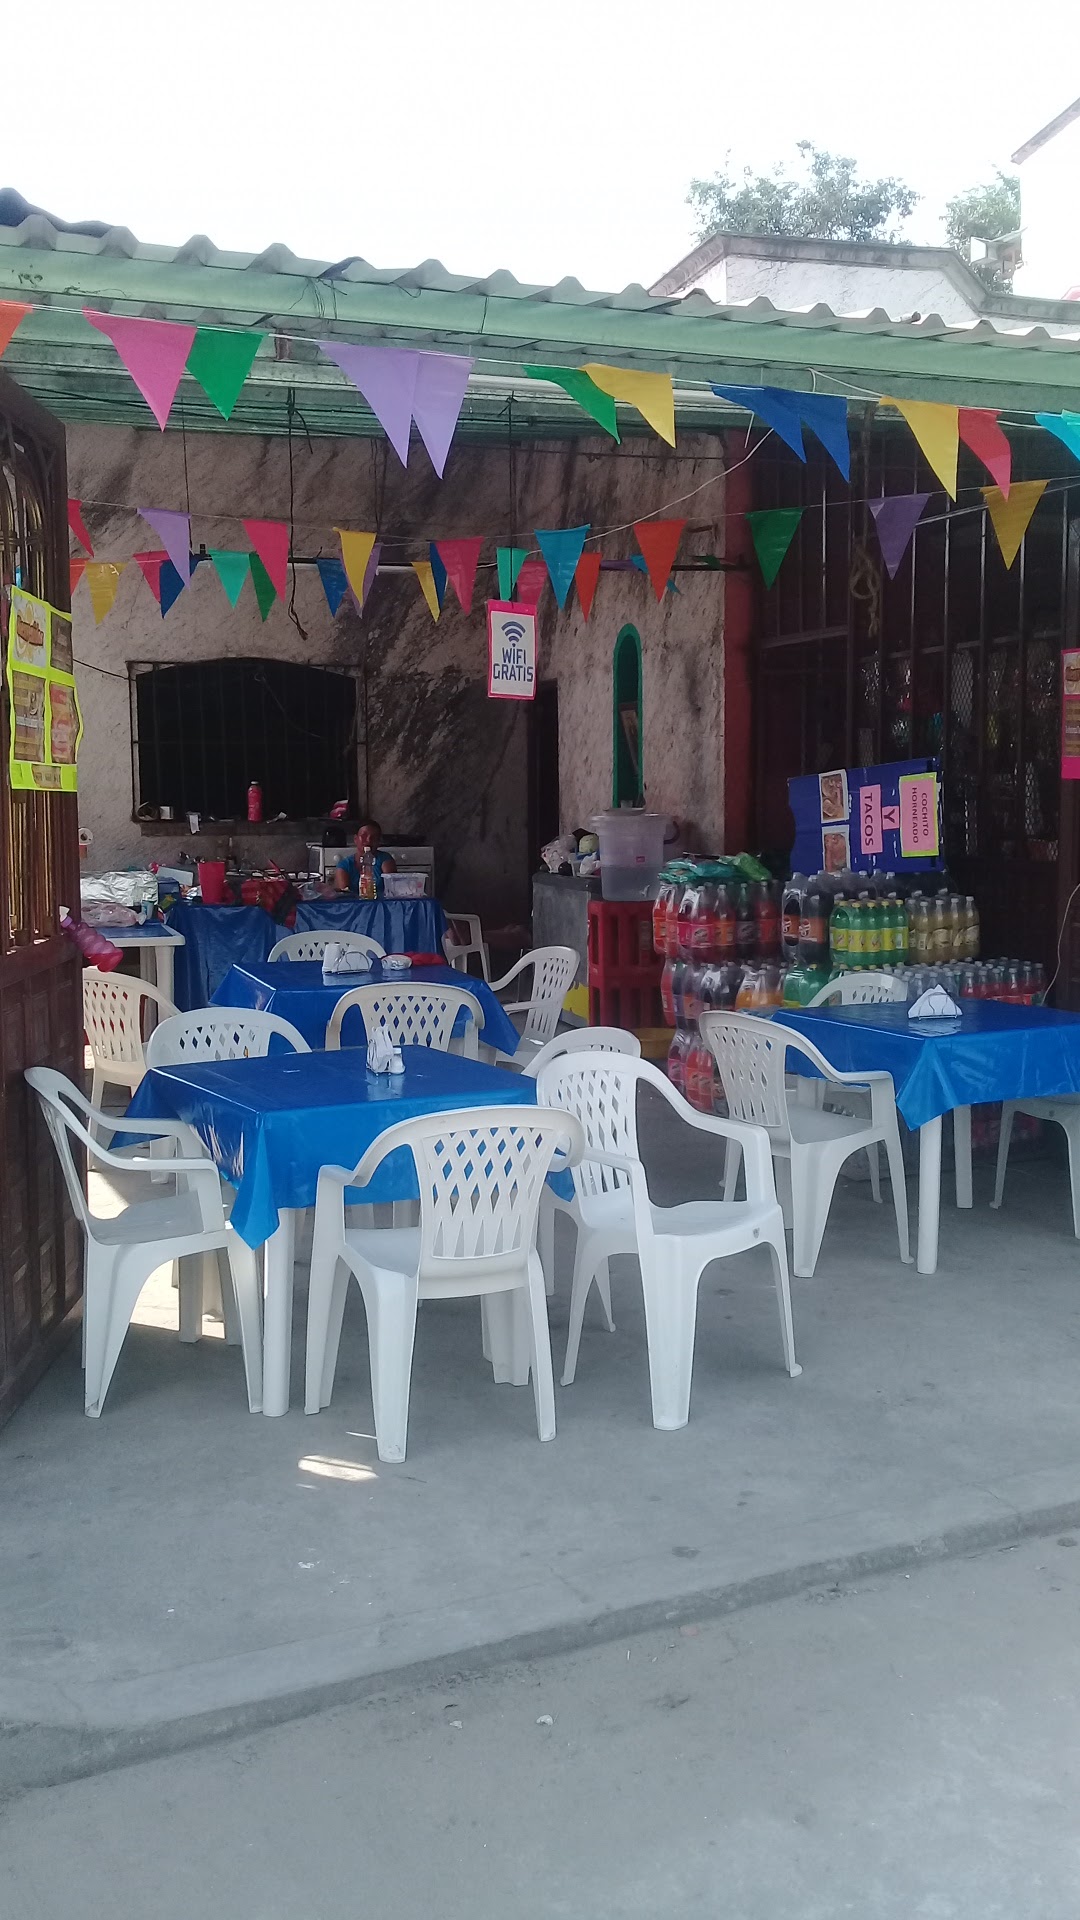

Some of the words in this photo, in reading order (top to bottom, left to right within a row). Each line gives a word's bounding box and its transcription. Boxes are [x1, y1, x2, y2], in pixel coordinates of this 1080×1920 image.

[493, 663, 534, 682] GRATIS
[864, 793, 874, 847] TACOS
[883, 809, 896, 824] Y
[911, 787, 919, 844] HORNEADO
[921, 792, 930, 837] COCHITO
